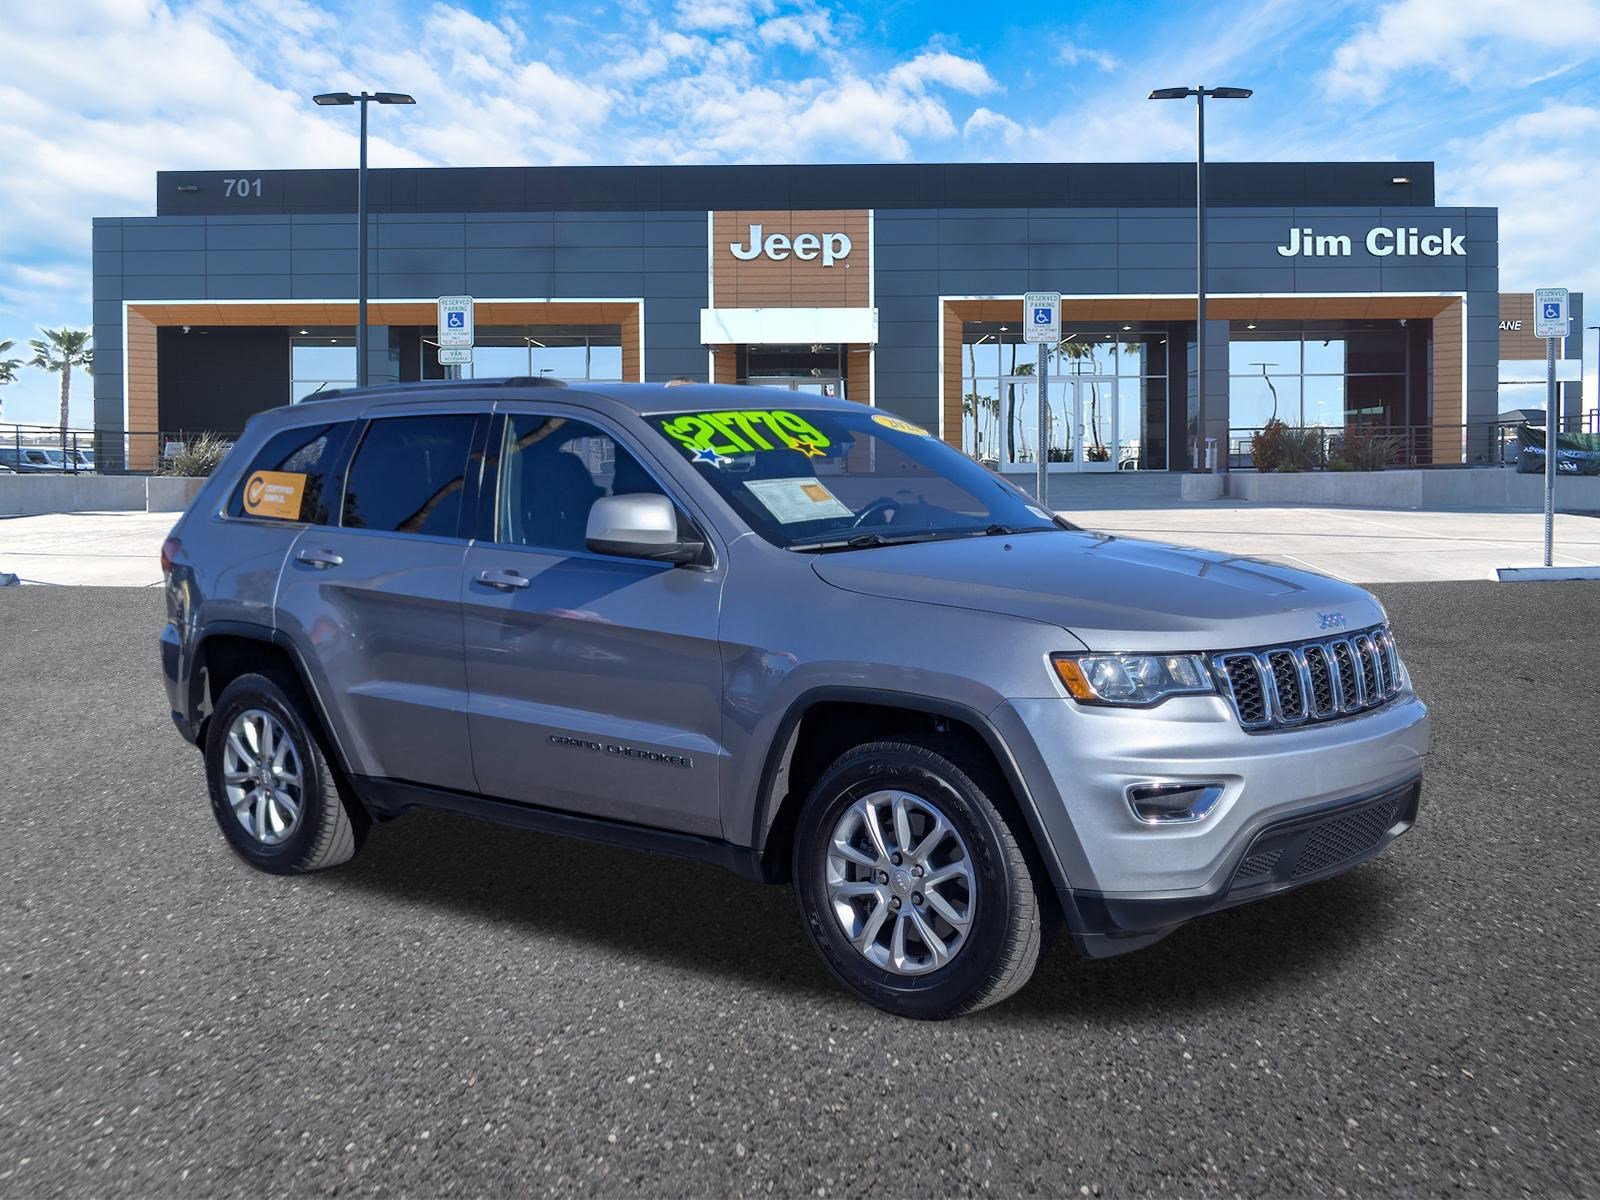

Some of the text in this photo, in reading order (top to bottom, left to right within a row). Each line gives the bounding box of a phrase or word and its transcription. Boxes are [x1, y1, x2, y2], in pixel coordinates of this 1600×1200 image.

[223, 178, 263, 198] 701
[729, 224, 852, 267] Jeep
[1277, 227, 1467, 256] Jim Click
[661, 410, 831, 455] $21779
[549, 735, 694, 769] GRAND CHEROKEE
